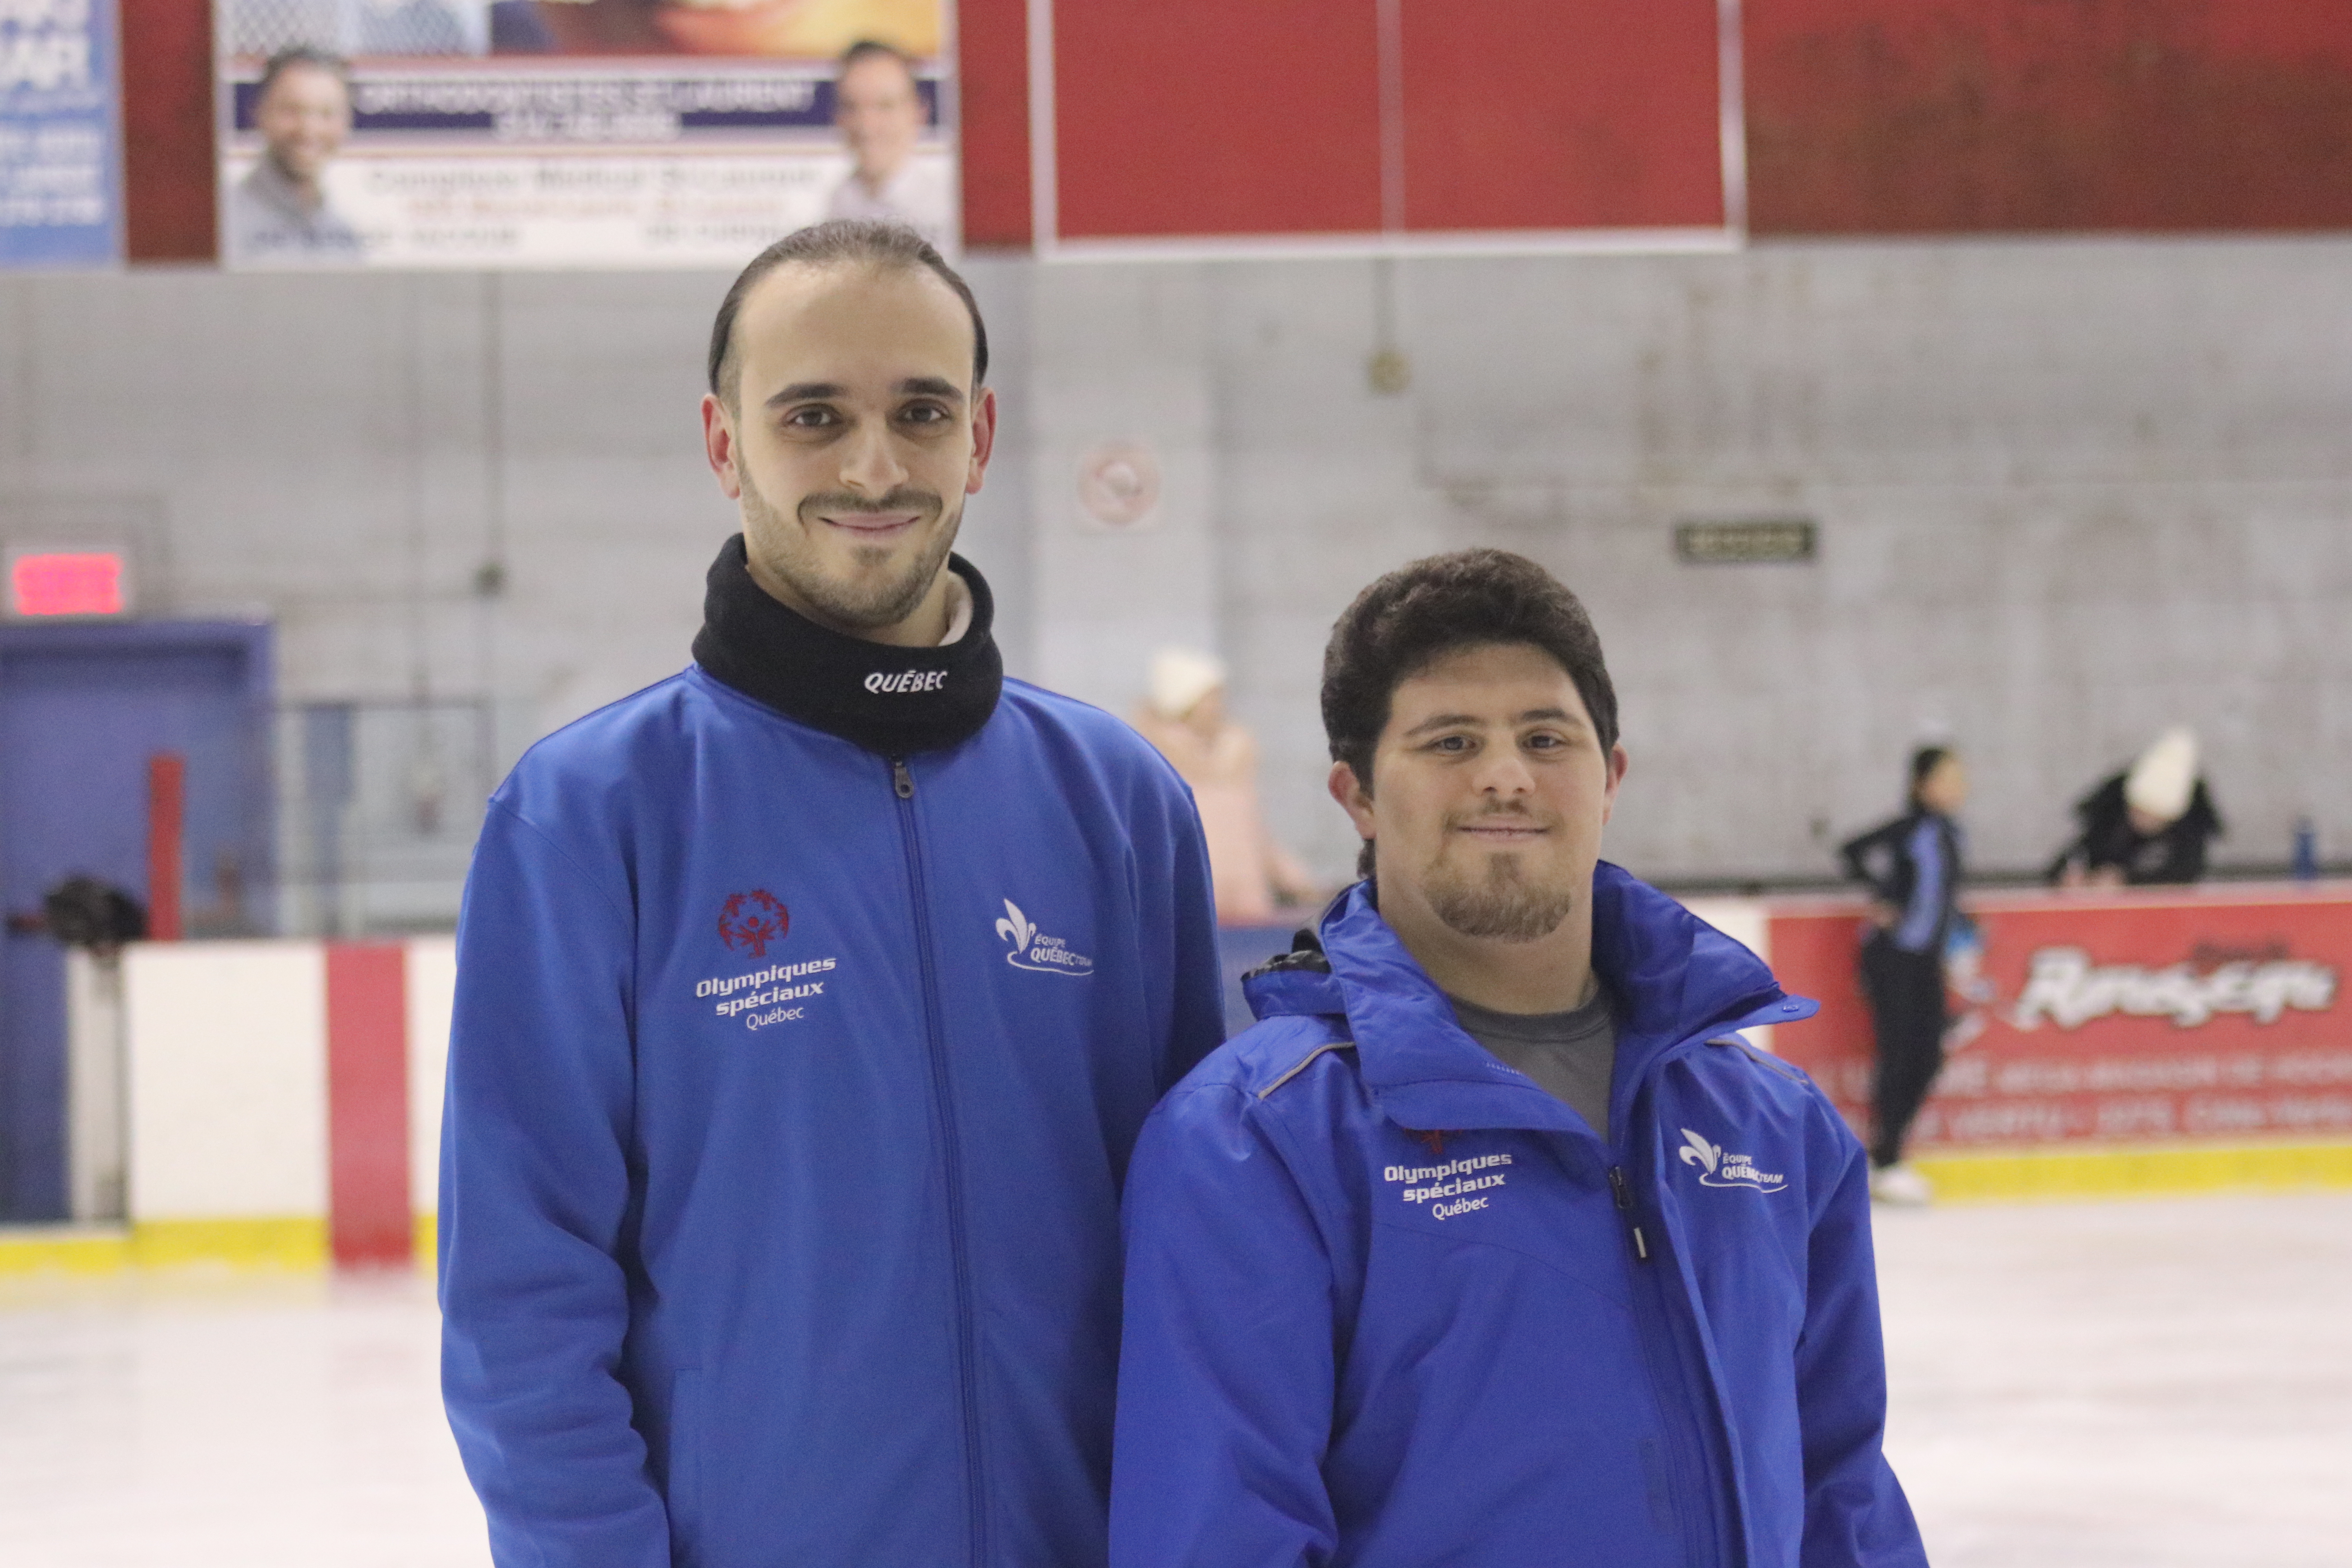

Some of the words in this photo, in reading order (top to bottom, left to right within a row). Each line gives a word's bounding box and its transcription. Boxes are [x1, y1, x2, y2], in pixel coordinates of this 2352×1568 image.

[864, 670, 948, 694] QUÉBEC
[696, 958, 837, 998] Olympiques
[716, 982, 824, 1017] spéciaux
[746, 1006, 804, 1031] Québec
[1384, 1154, 1512, 1184] Olympiques
[1403, 1174, 1505, 1203] spéciaux
[1432, 1197, 1489, 1221] Québec
